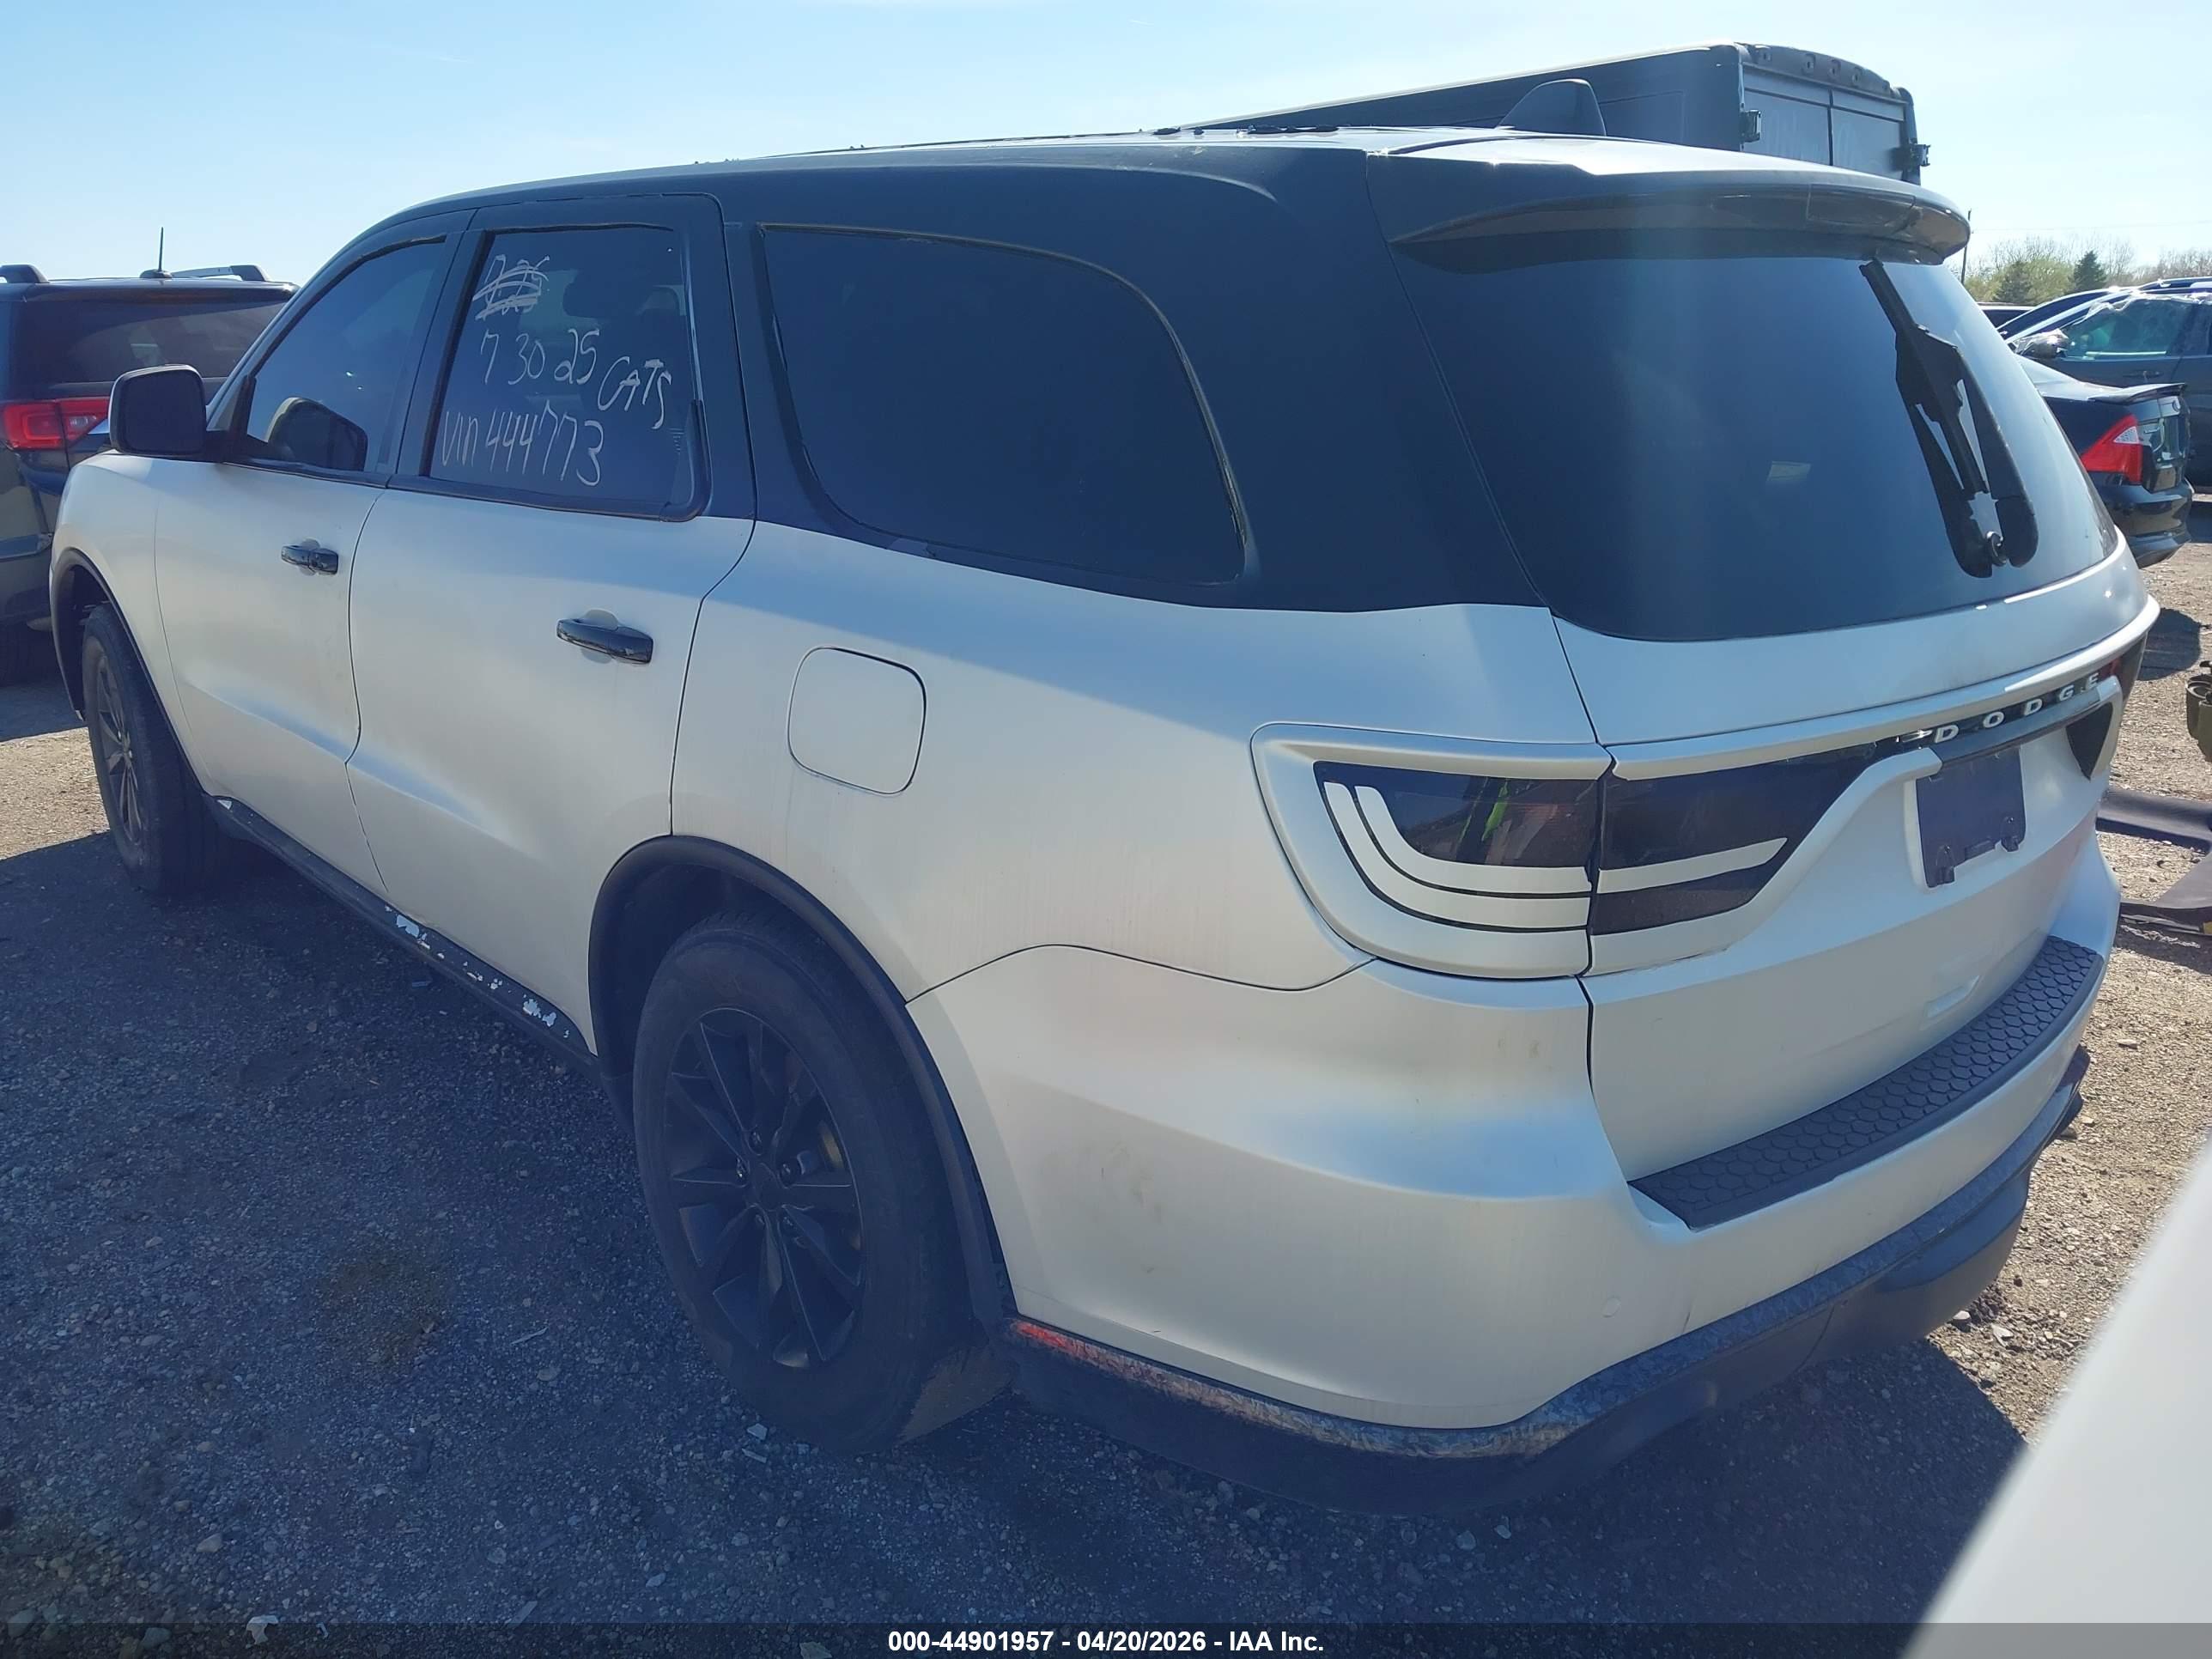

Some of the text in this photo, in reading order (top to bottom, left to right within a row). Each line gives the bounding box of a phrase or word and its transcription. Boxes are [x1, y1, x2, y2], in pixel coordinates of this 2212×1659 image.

[480, 327, 599, 386] 7 30 25
[485, 399, 605, 487] 444773
[1934, 672, 2100, 744] DODGE
